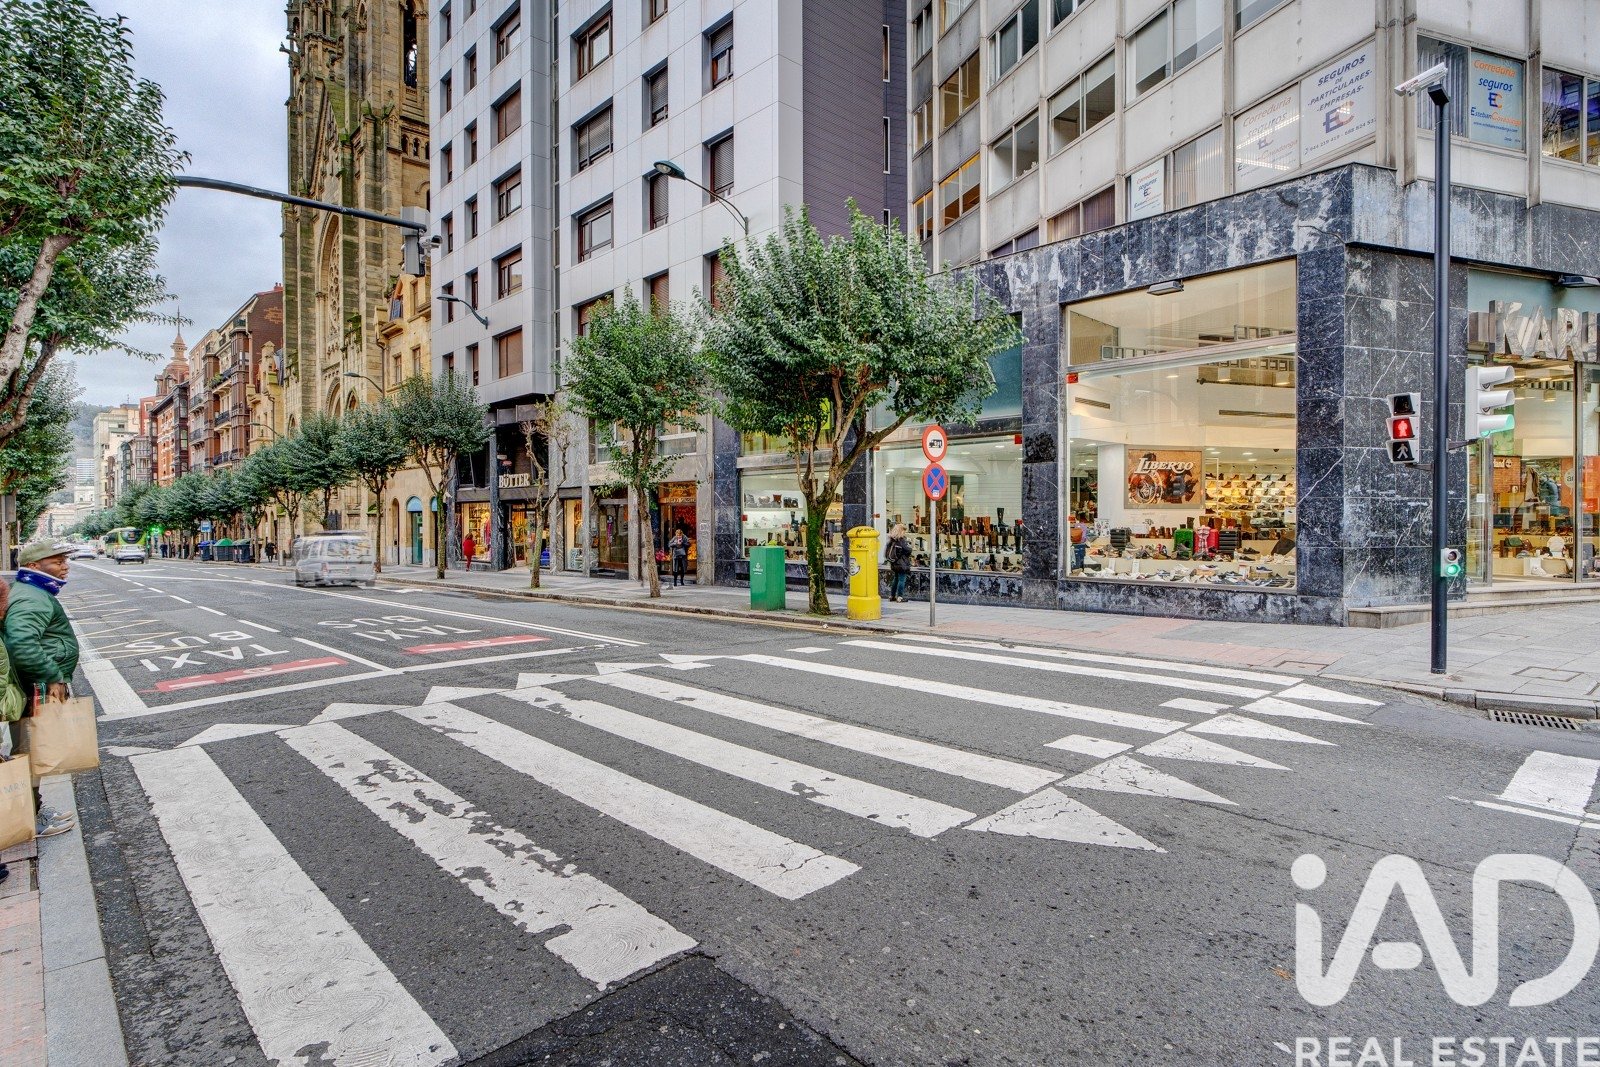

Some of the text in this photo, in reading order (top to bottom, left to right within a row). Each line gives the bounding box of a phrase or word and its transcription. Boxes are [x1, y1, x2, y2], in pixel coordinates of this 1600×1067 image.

[1318, 54, 1366, 86] SEGUROS
[1478, 77, 1514, 92] seguros
[317, 615, 429, 630] BUS
[126, 631, 254, 650] BUS
[353, 625, 482, 641] TAXI
[139, 644, 290, 672] TAXI
